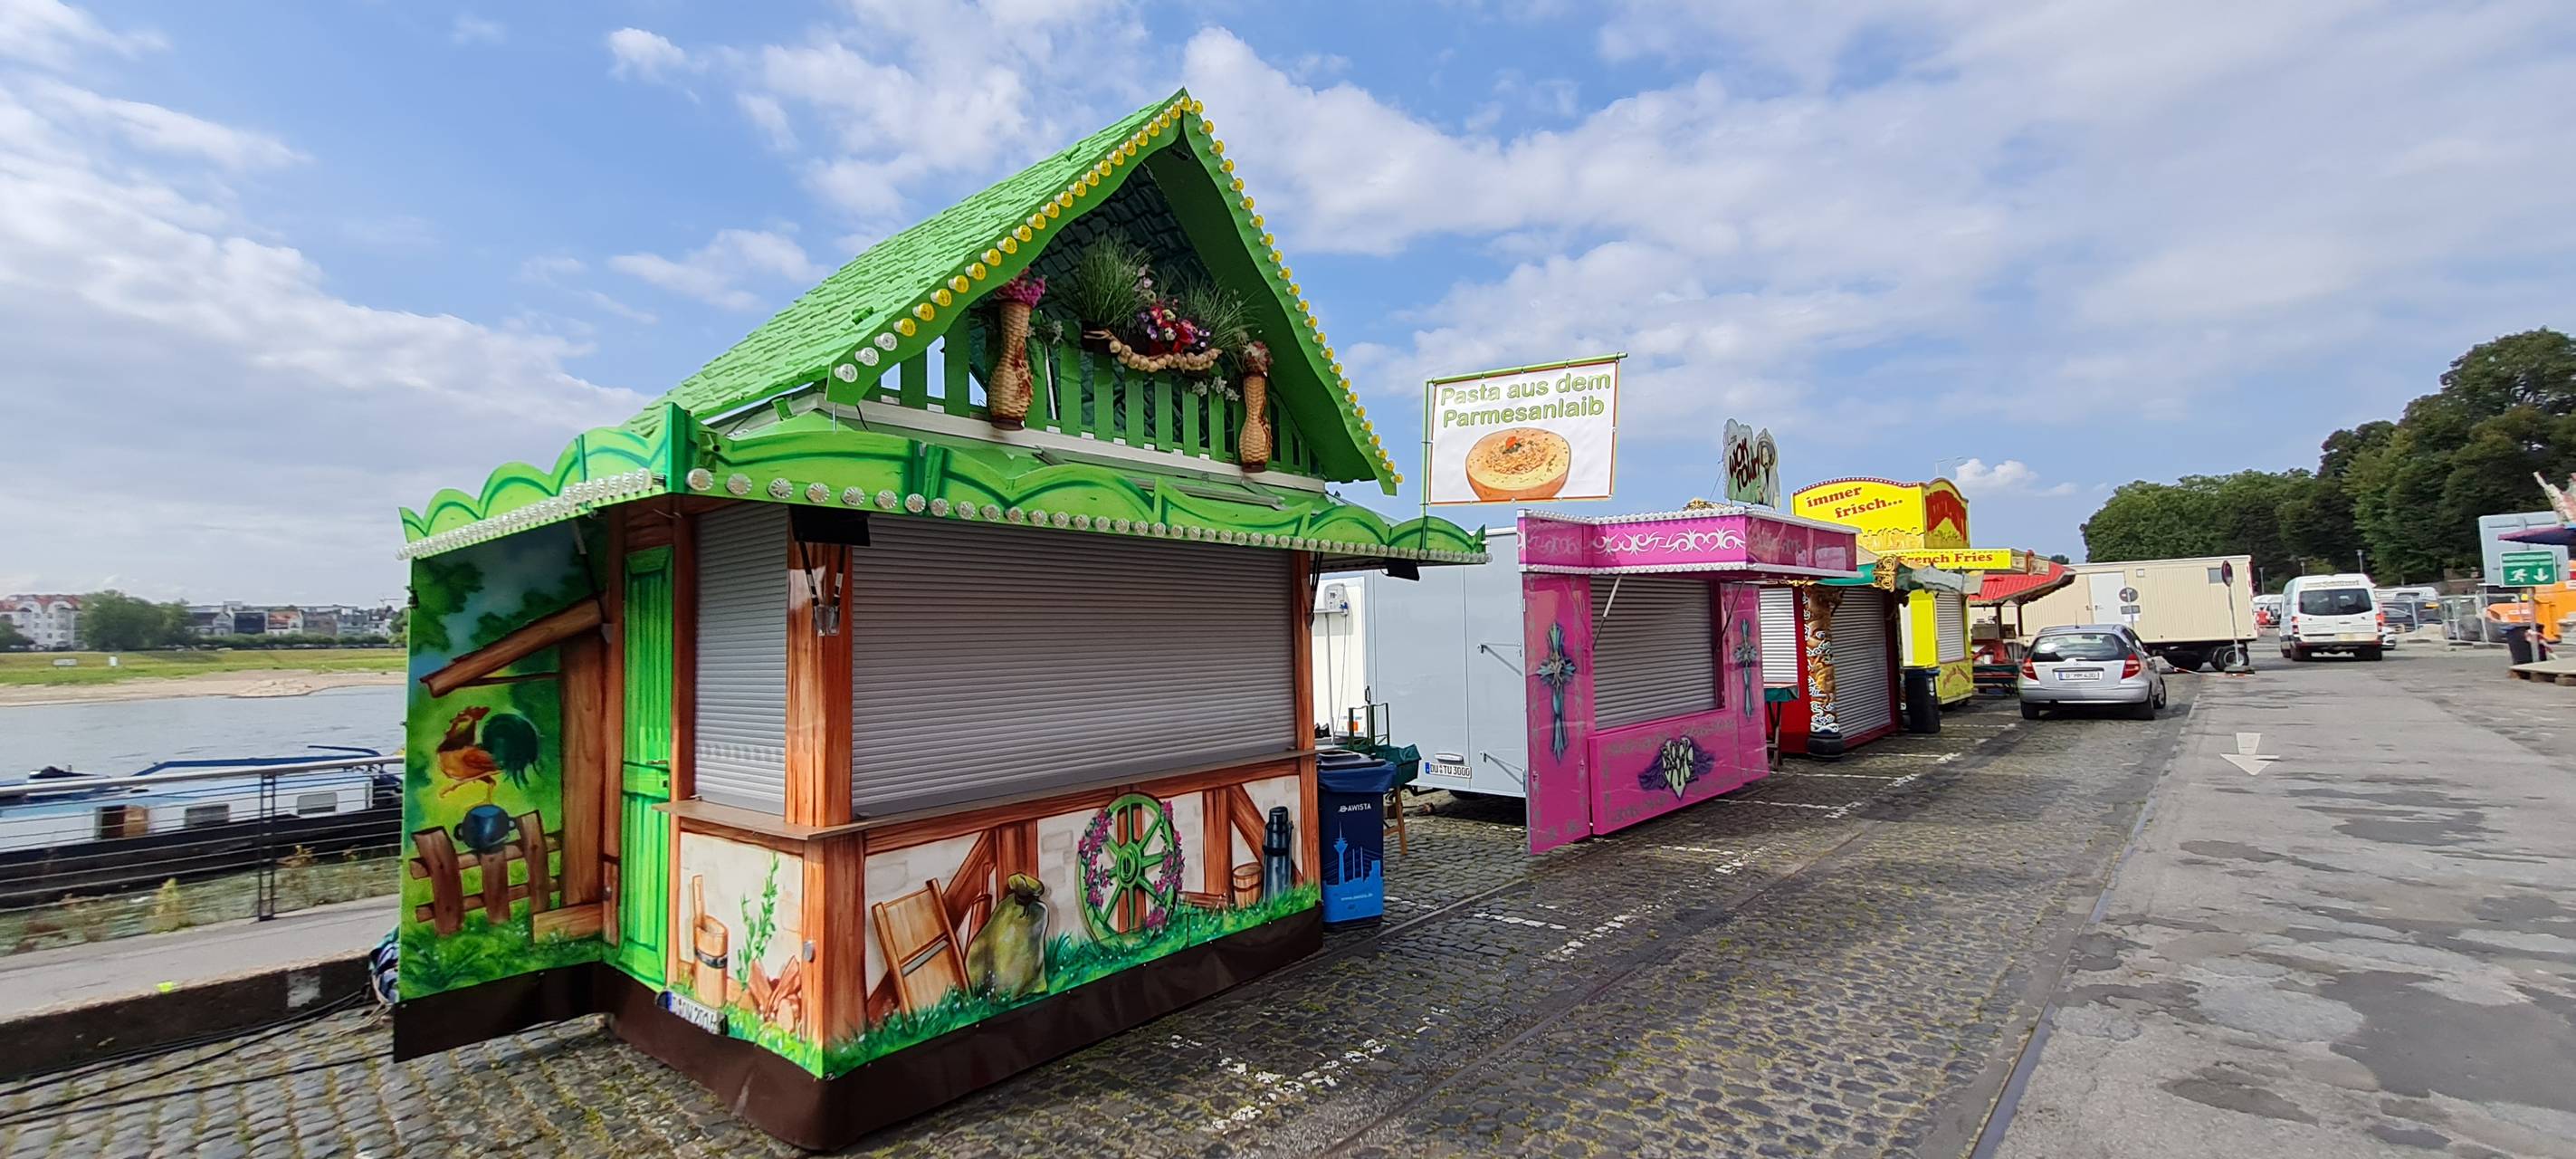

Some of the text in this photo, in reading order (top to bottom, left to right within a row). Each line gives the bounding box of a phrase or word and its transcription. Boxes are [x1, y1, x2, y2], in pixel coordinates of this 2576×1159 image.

[1440, 372, 1611, 406] Pasta aus dem
[1443, 395, 1605, 427] Parmesanlaib
[1806, 486, 1862, 508] immer
[1954, 552, 1993, 562] Fries
[1347, 802, 1372, 812] AWISTA
